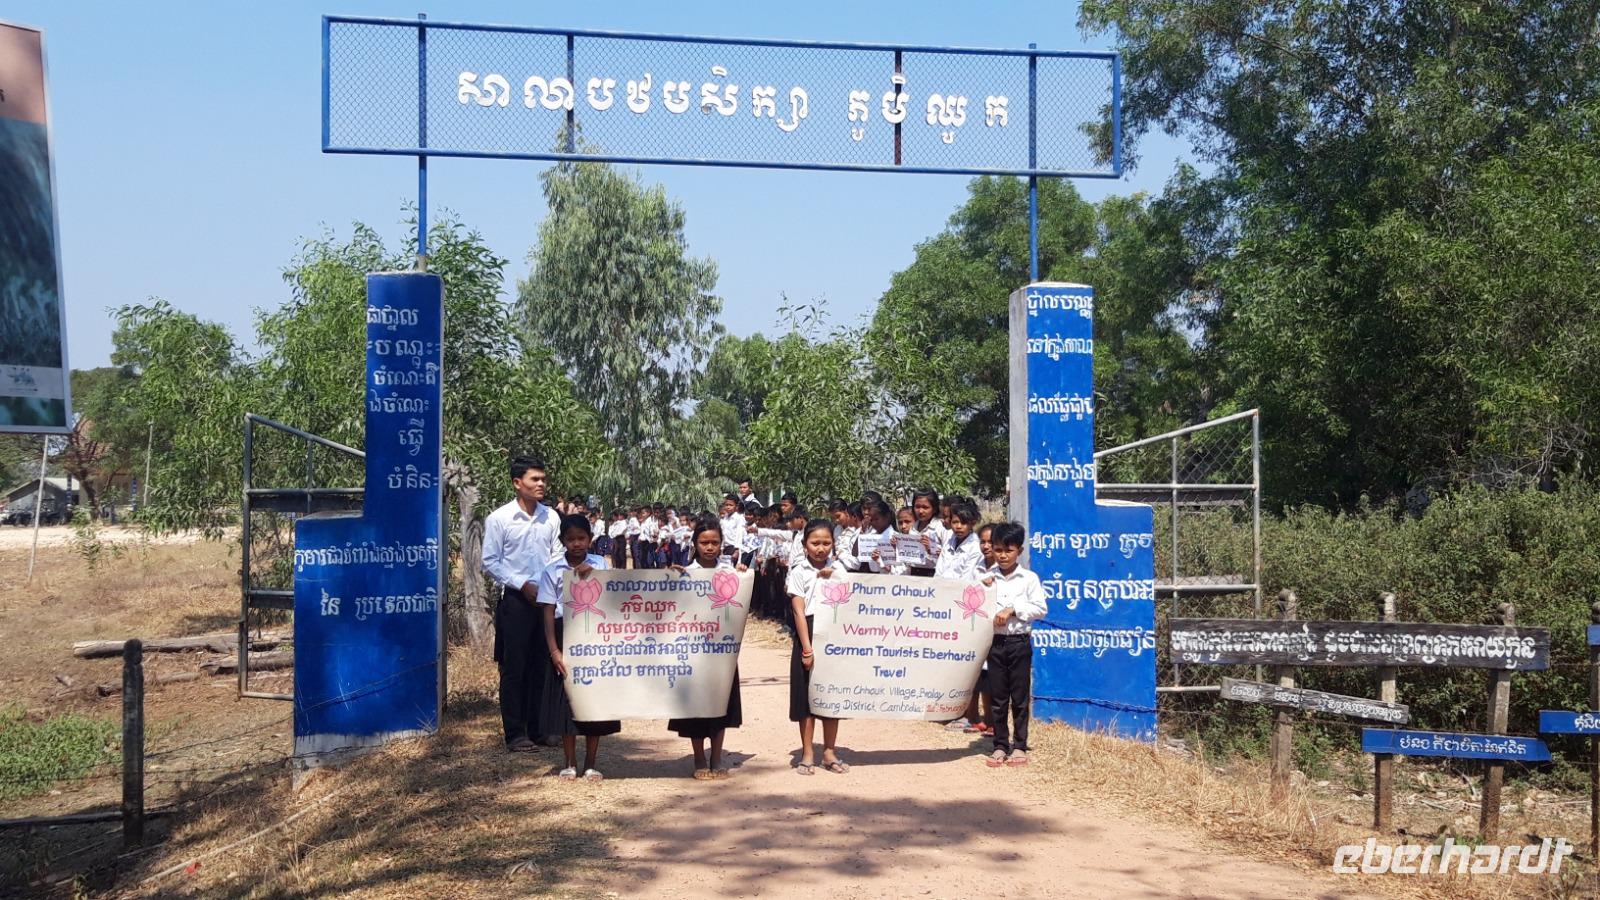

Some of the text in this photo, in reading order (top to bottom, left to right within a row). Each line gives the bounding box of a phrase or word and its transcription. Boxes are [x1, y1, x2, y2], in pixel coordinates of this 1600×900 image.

[852, 582, 936, 598] Phum Chhouk
[858, 603, 952, 621] Primary School
[842, 623, 960, 642] Warmly Welcomes
[824, 643, 977, 662] German Tourists Eberhardt
[872, 665, 907, 678] Travel
